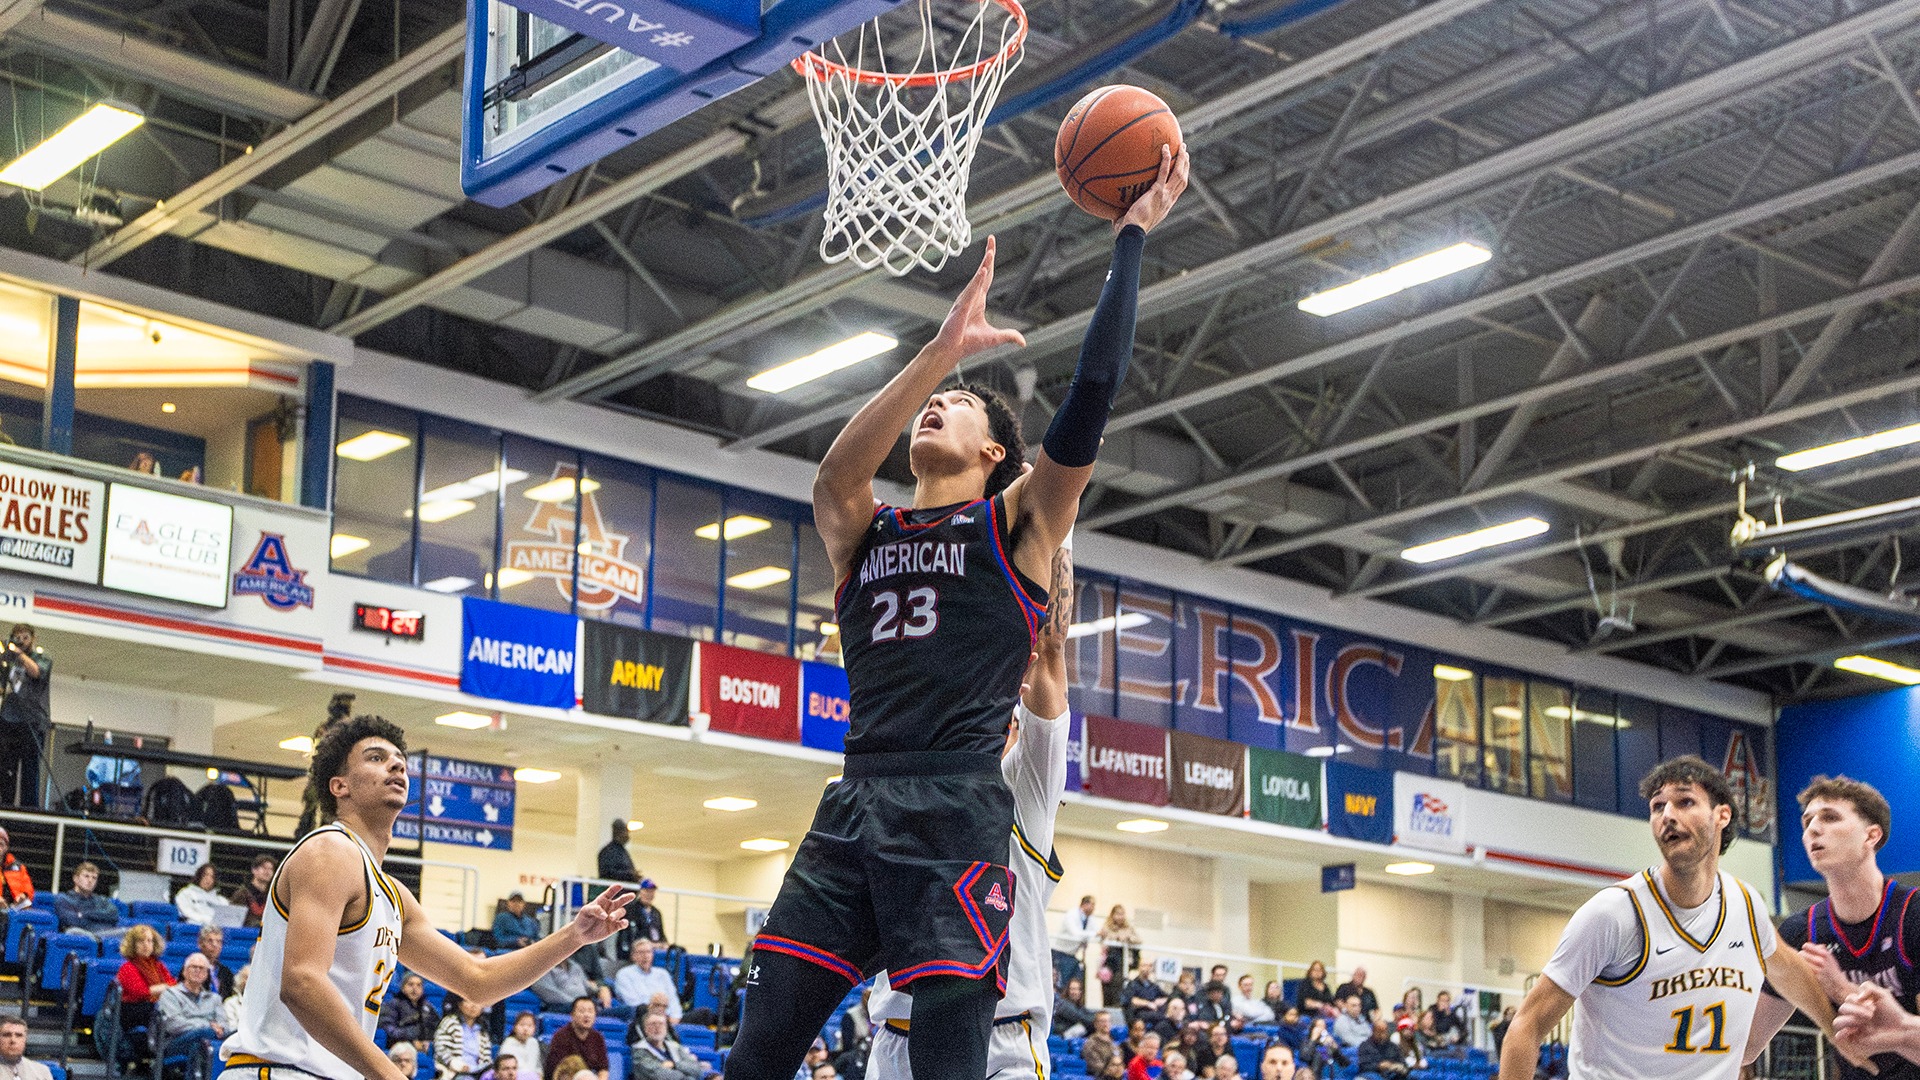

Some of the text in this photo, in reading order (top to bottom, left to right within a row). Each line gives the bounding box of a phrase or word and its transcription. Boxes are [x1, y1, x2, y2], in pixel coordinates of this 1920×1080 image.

[62, 484, 91, 510] THE
[0, 497, 89, 545] AGLES
[160, 542, 218, 565] CLUB
[860, 541, 966, 588] AMERICAN
[870, 585, 940, 642] 23
[468, 635, 574, 676] AMERICAN
[610, 659, 665, 692] ARMY
[719, 674, 781, 709] BOSTON
[1066, 577, 1574, 798] ERICAN
[444, 760, 494, 782] ARENA
[1090, 746, 1164, 780] LAFAYETTE
[1184, 761, 1234, 790] LEHIGH
[1261, 775, 1311, 802] LOYOLA
[1345, 792, 1377, 817] NAVY
[171, 846, 198, 866] 103
[1648, 966, 1753, 1002] DREXEL
[1664, 1000, 1731, 1055] 11
